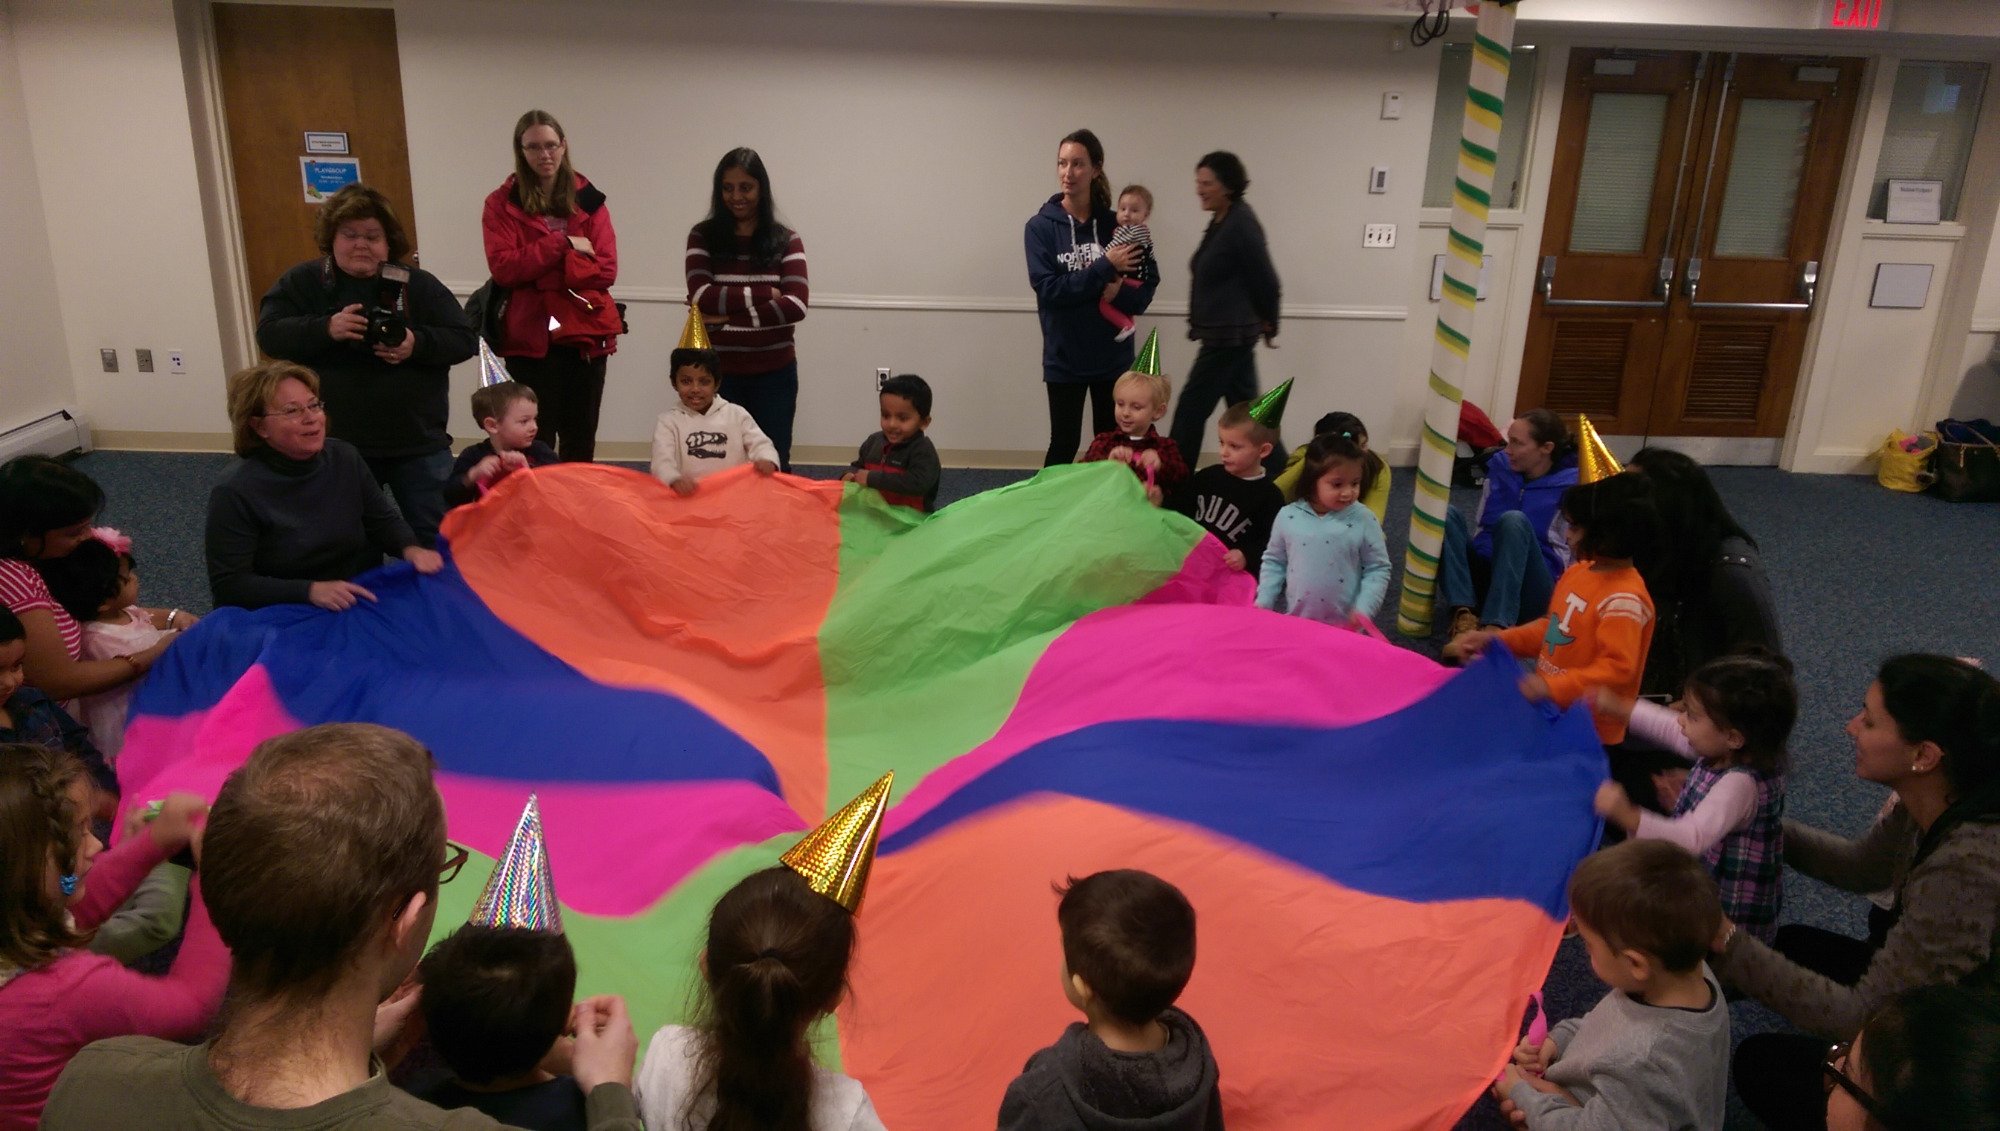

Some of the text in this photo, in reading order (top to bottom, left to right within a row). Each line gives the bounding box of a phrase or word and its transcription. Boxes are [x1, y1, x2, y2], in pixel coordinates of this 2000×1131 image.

[1831, 0, 1882, 28] EXIT
[1057, 252, 1092, 264] NORTH
[1071, 243, 1091, 254] THE
[1558, 592, 1588, 633] T
